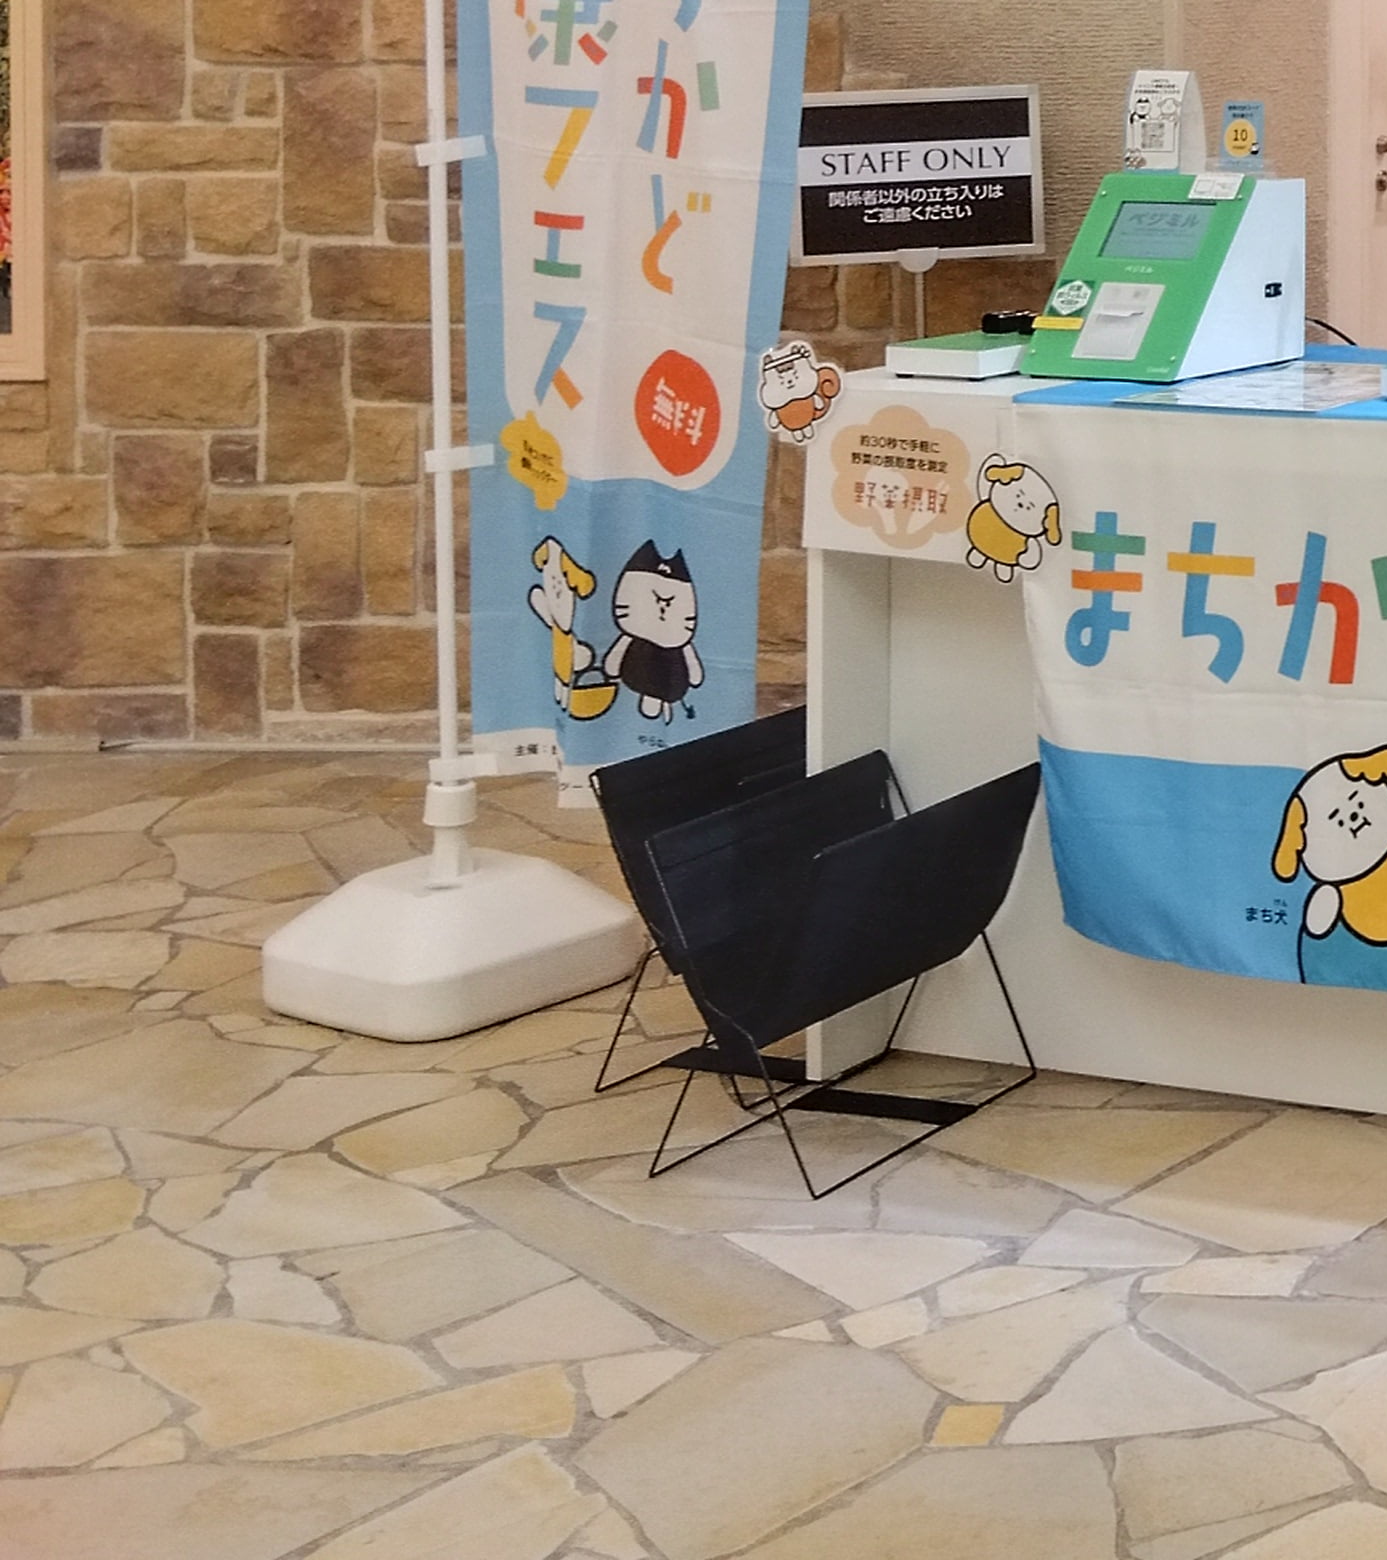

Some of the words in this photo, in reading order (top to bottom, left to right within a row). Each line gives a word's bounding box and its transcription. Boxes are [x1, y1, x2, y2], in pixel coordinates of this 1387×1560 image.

[1233, 129, 1248, 142] 10
[821, 149, 911, 177] STAFF
[923, 144, 1012, 172] ONLY
[828, 183, 1004, 208] 関係者以外の立ち入りは
[863, 205, 972, 224] ご遠慮ください
[652, 376, 706, 446] 無料
[859, 434, 941, 454] 約30秒で手軽に
[1245, 906, 1288, 926] まち犬
